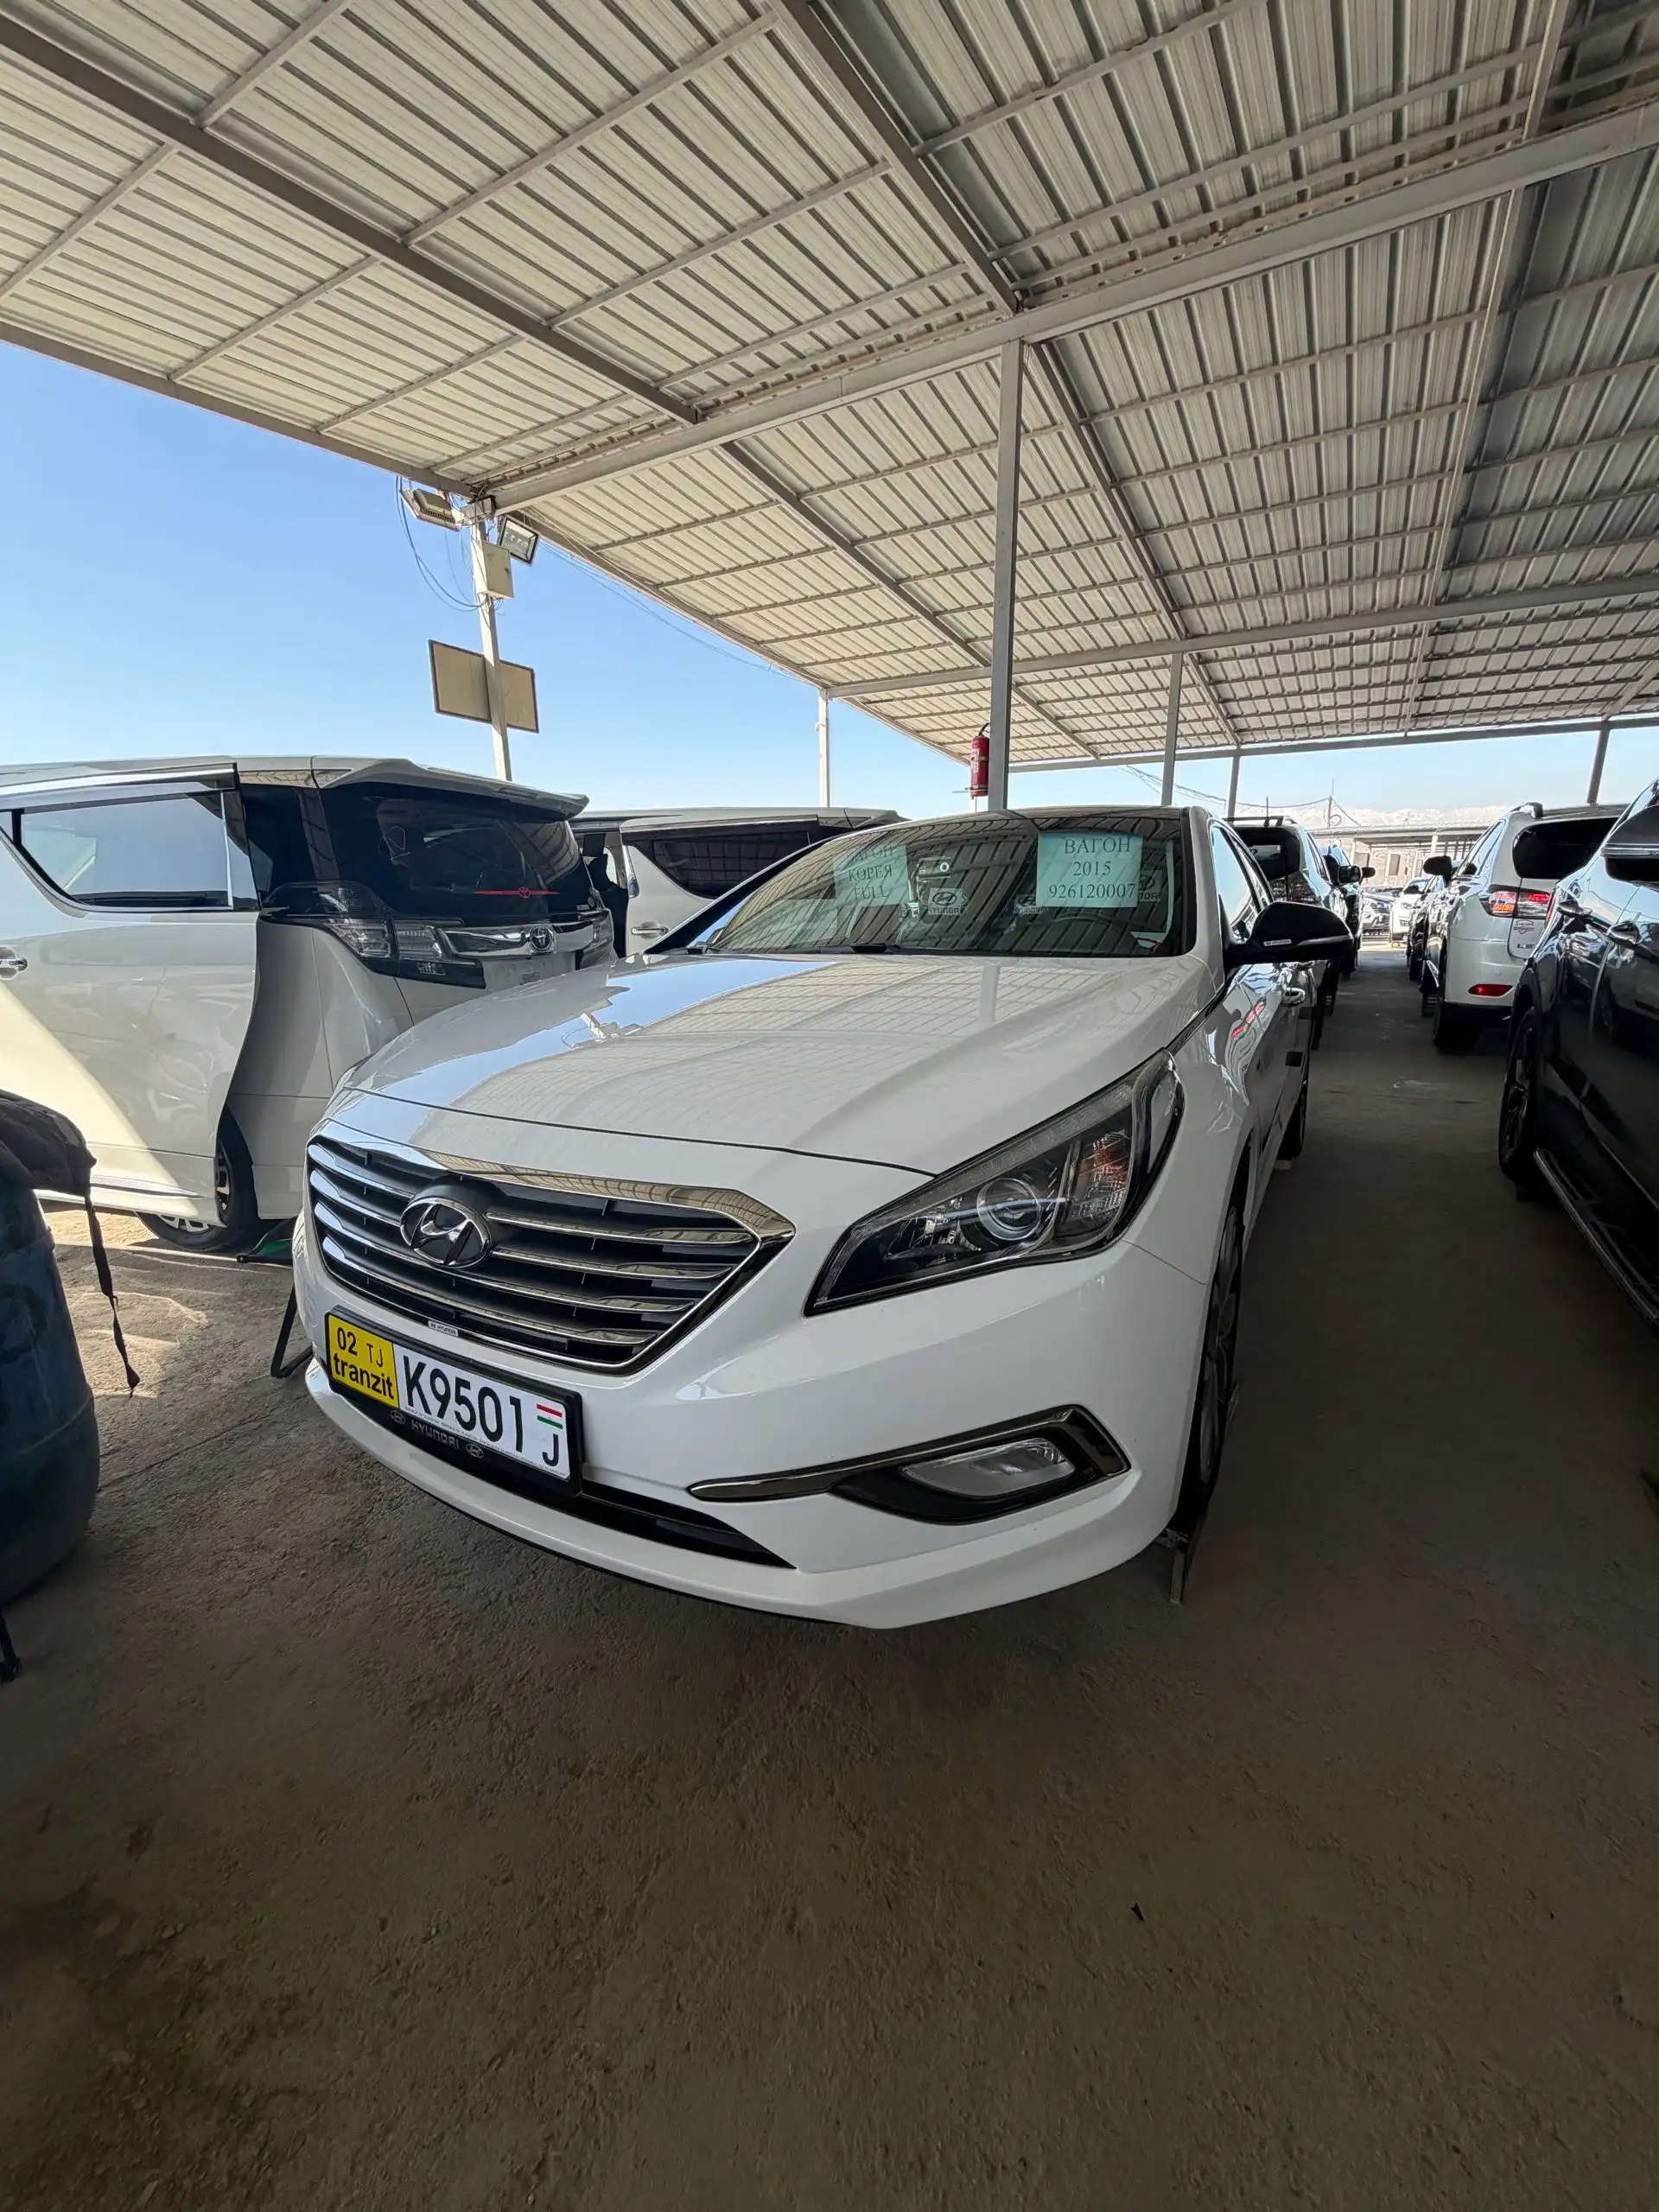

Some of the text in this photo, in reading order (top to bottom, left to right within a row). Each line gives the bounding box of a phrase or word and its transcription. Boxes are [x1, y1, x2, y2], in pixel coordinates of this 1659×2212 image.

[1065, 836, 1131, 855] ВАГОН
[848, 864, 893, 882] КОРЕЯ
[1072, 861, 1111, 876] 2015
[855, 885, 889, 900] FULL
[1049, 883, 1137, 899] 926120007
[336, 1326, 384, 1368] 02 TJ
[334, 1352, 395, 1401] tranzit
[403, 1355, 559, 1467] K9501 J
[411, 1419, 460, 1449] HYUNDAI
